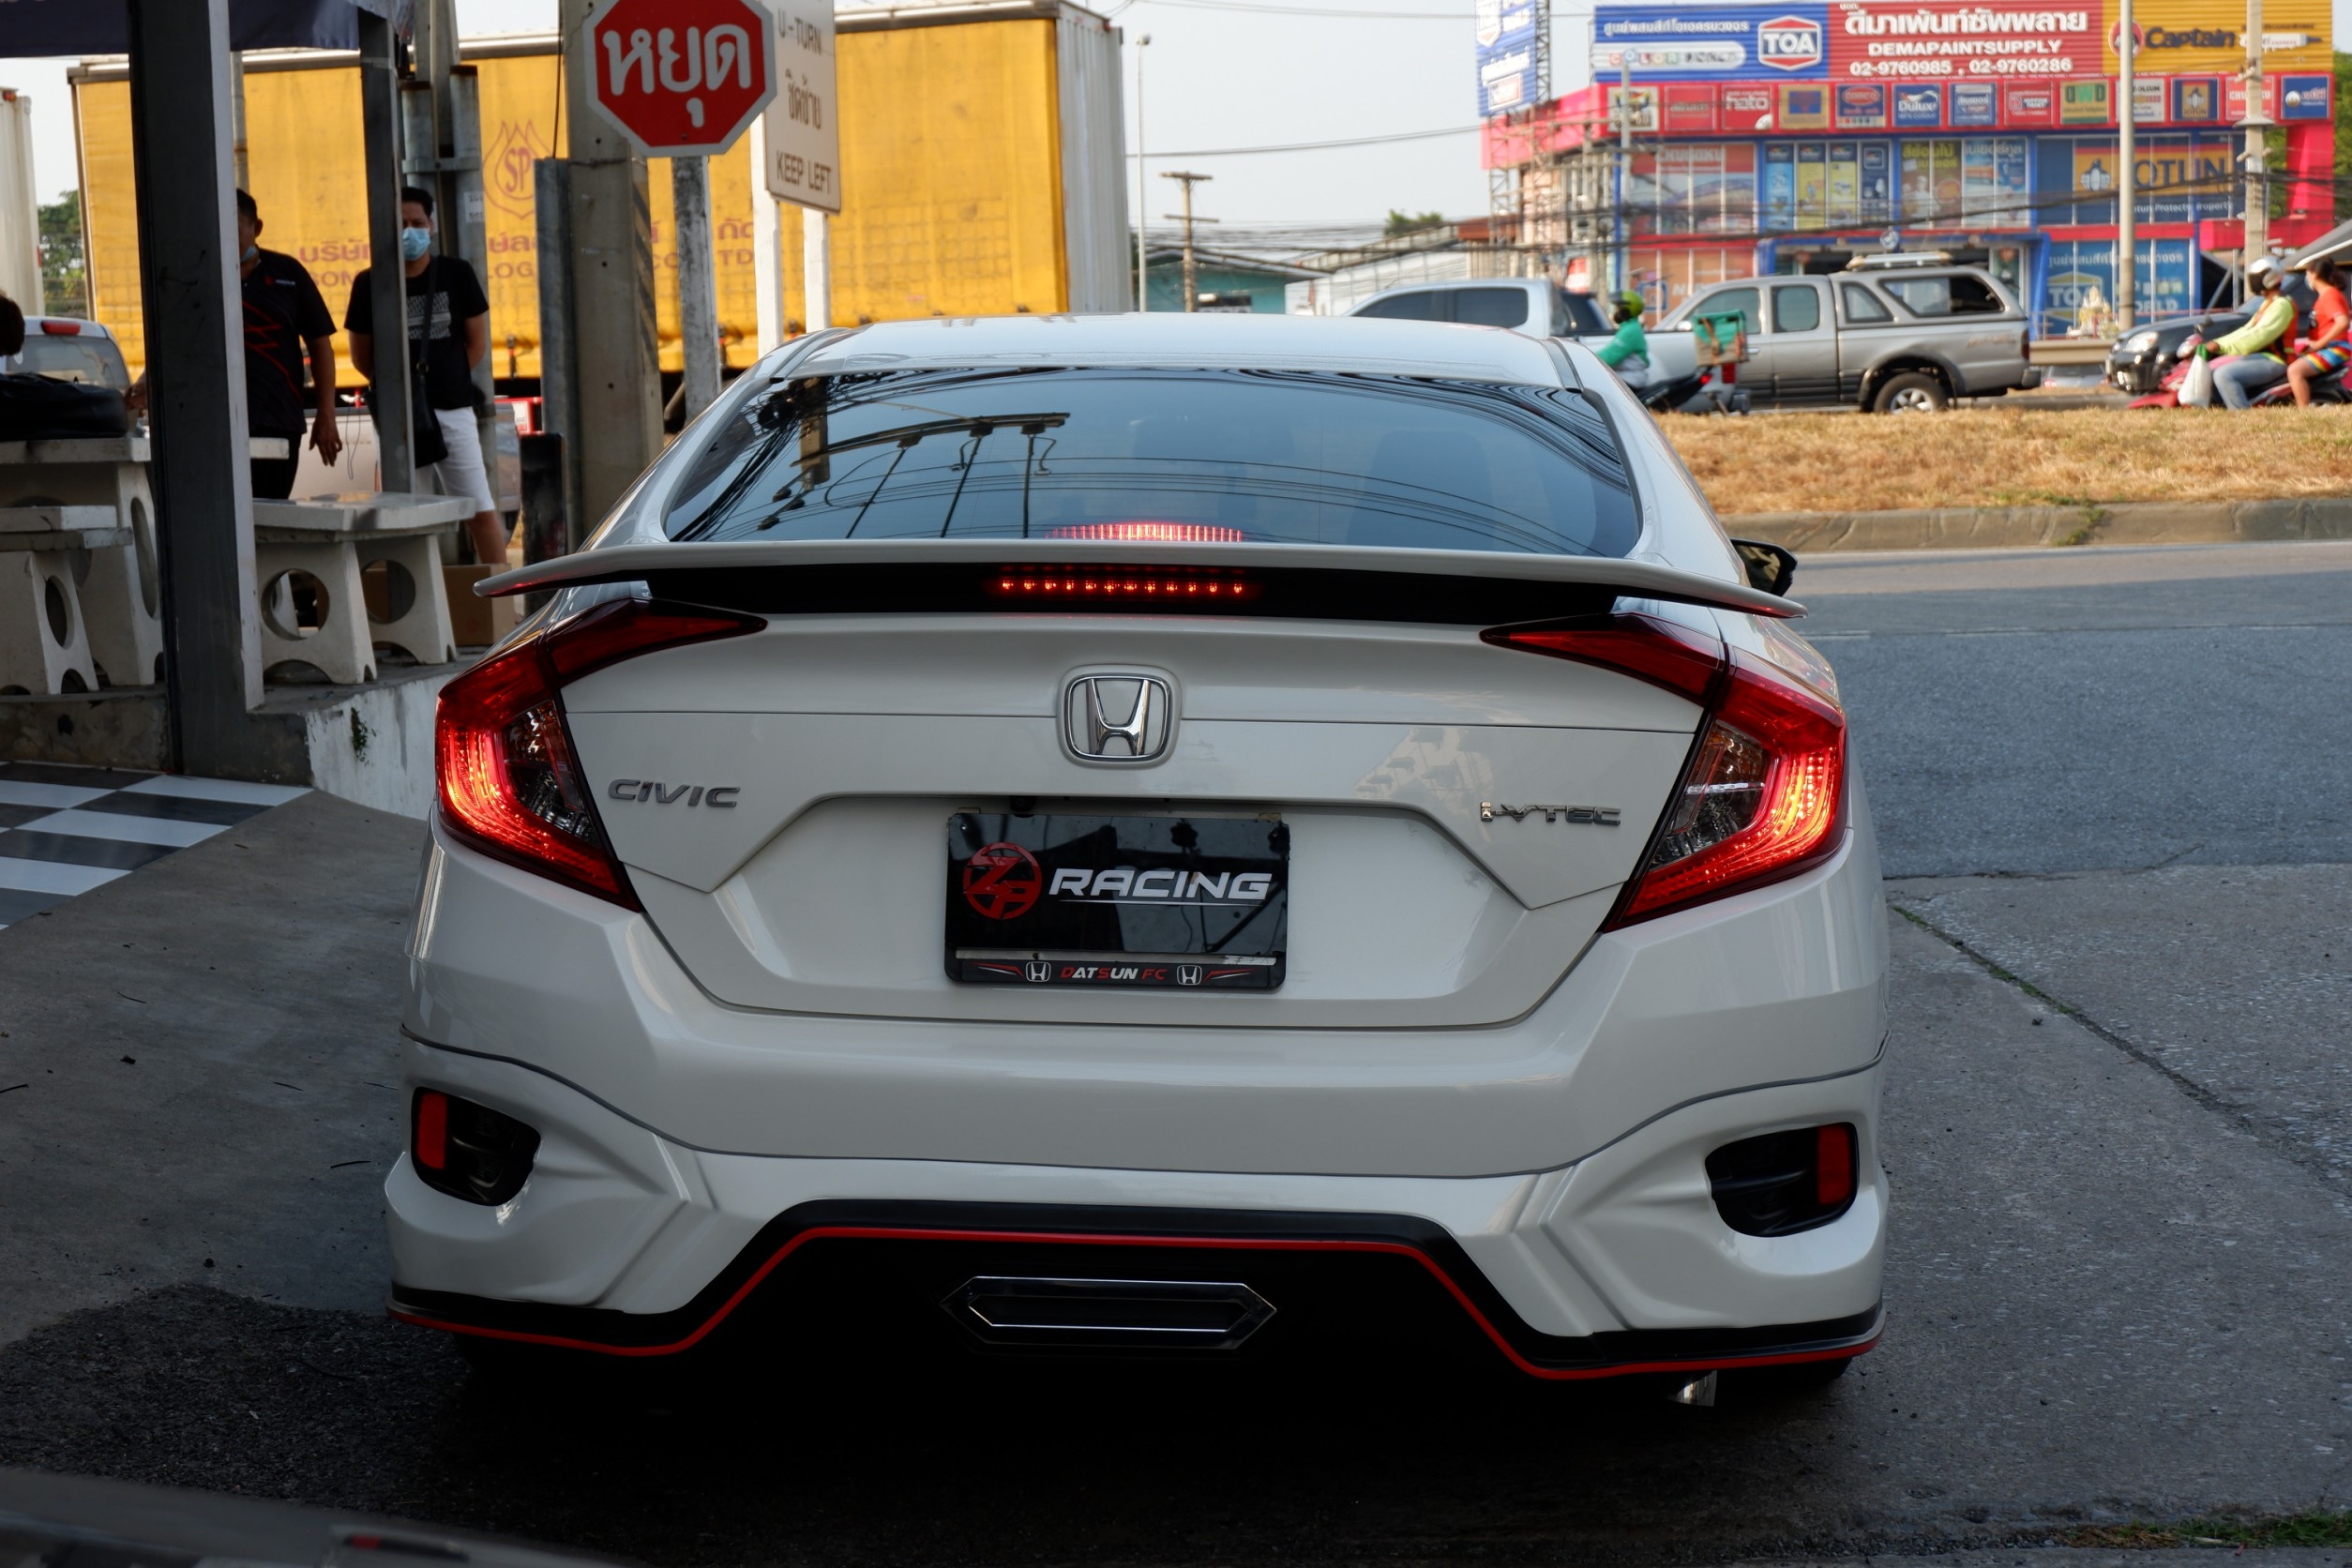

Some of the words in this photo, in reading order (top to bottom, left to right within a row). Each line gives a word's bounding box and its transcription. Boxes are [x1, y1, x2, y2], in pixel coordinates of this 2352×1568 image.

[1763, 33, 1816, 53] TOA
[1867, 39, 2063, 57] DEMAPAINTSUPPLY
[2145, 27, 2236, 49] Captain
[602, 23, 751, 128] หยุด
[1849, 60, 1952, 77] 02-9760985
[1968, 57, 2073, 73] 02-9760286
[1898, 101, 1933, 112] Dulux
[505, 146, 531, 192] SP
[776, 150, 804, 186] KEEP
[807, 159, 832, 195] LEFT
[2133, 156, 2226, 188] OTUN
[608, 779, 741, 807] CIVIC
[1048, 867, 1273, 900] RACING
[1060, 967, 1138, 980] DATSUN
[1141, 968, 1168, 980] FC
